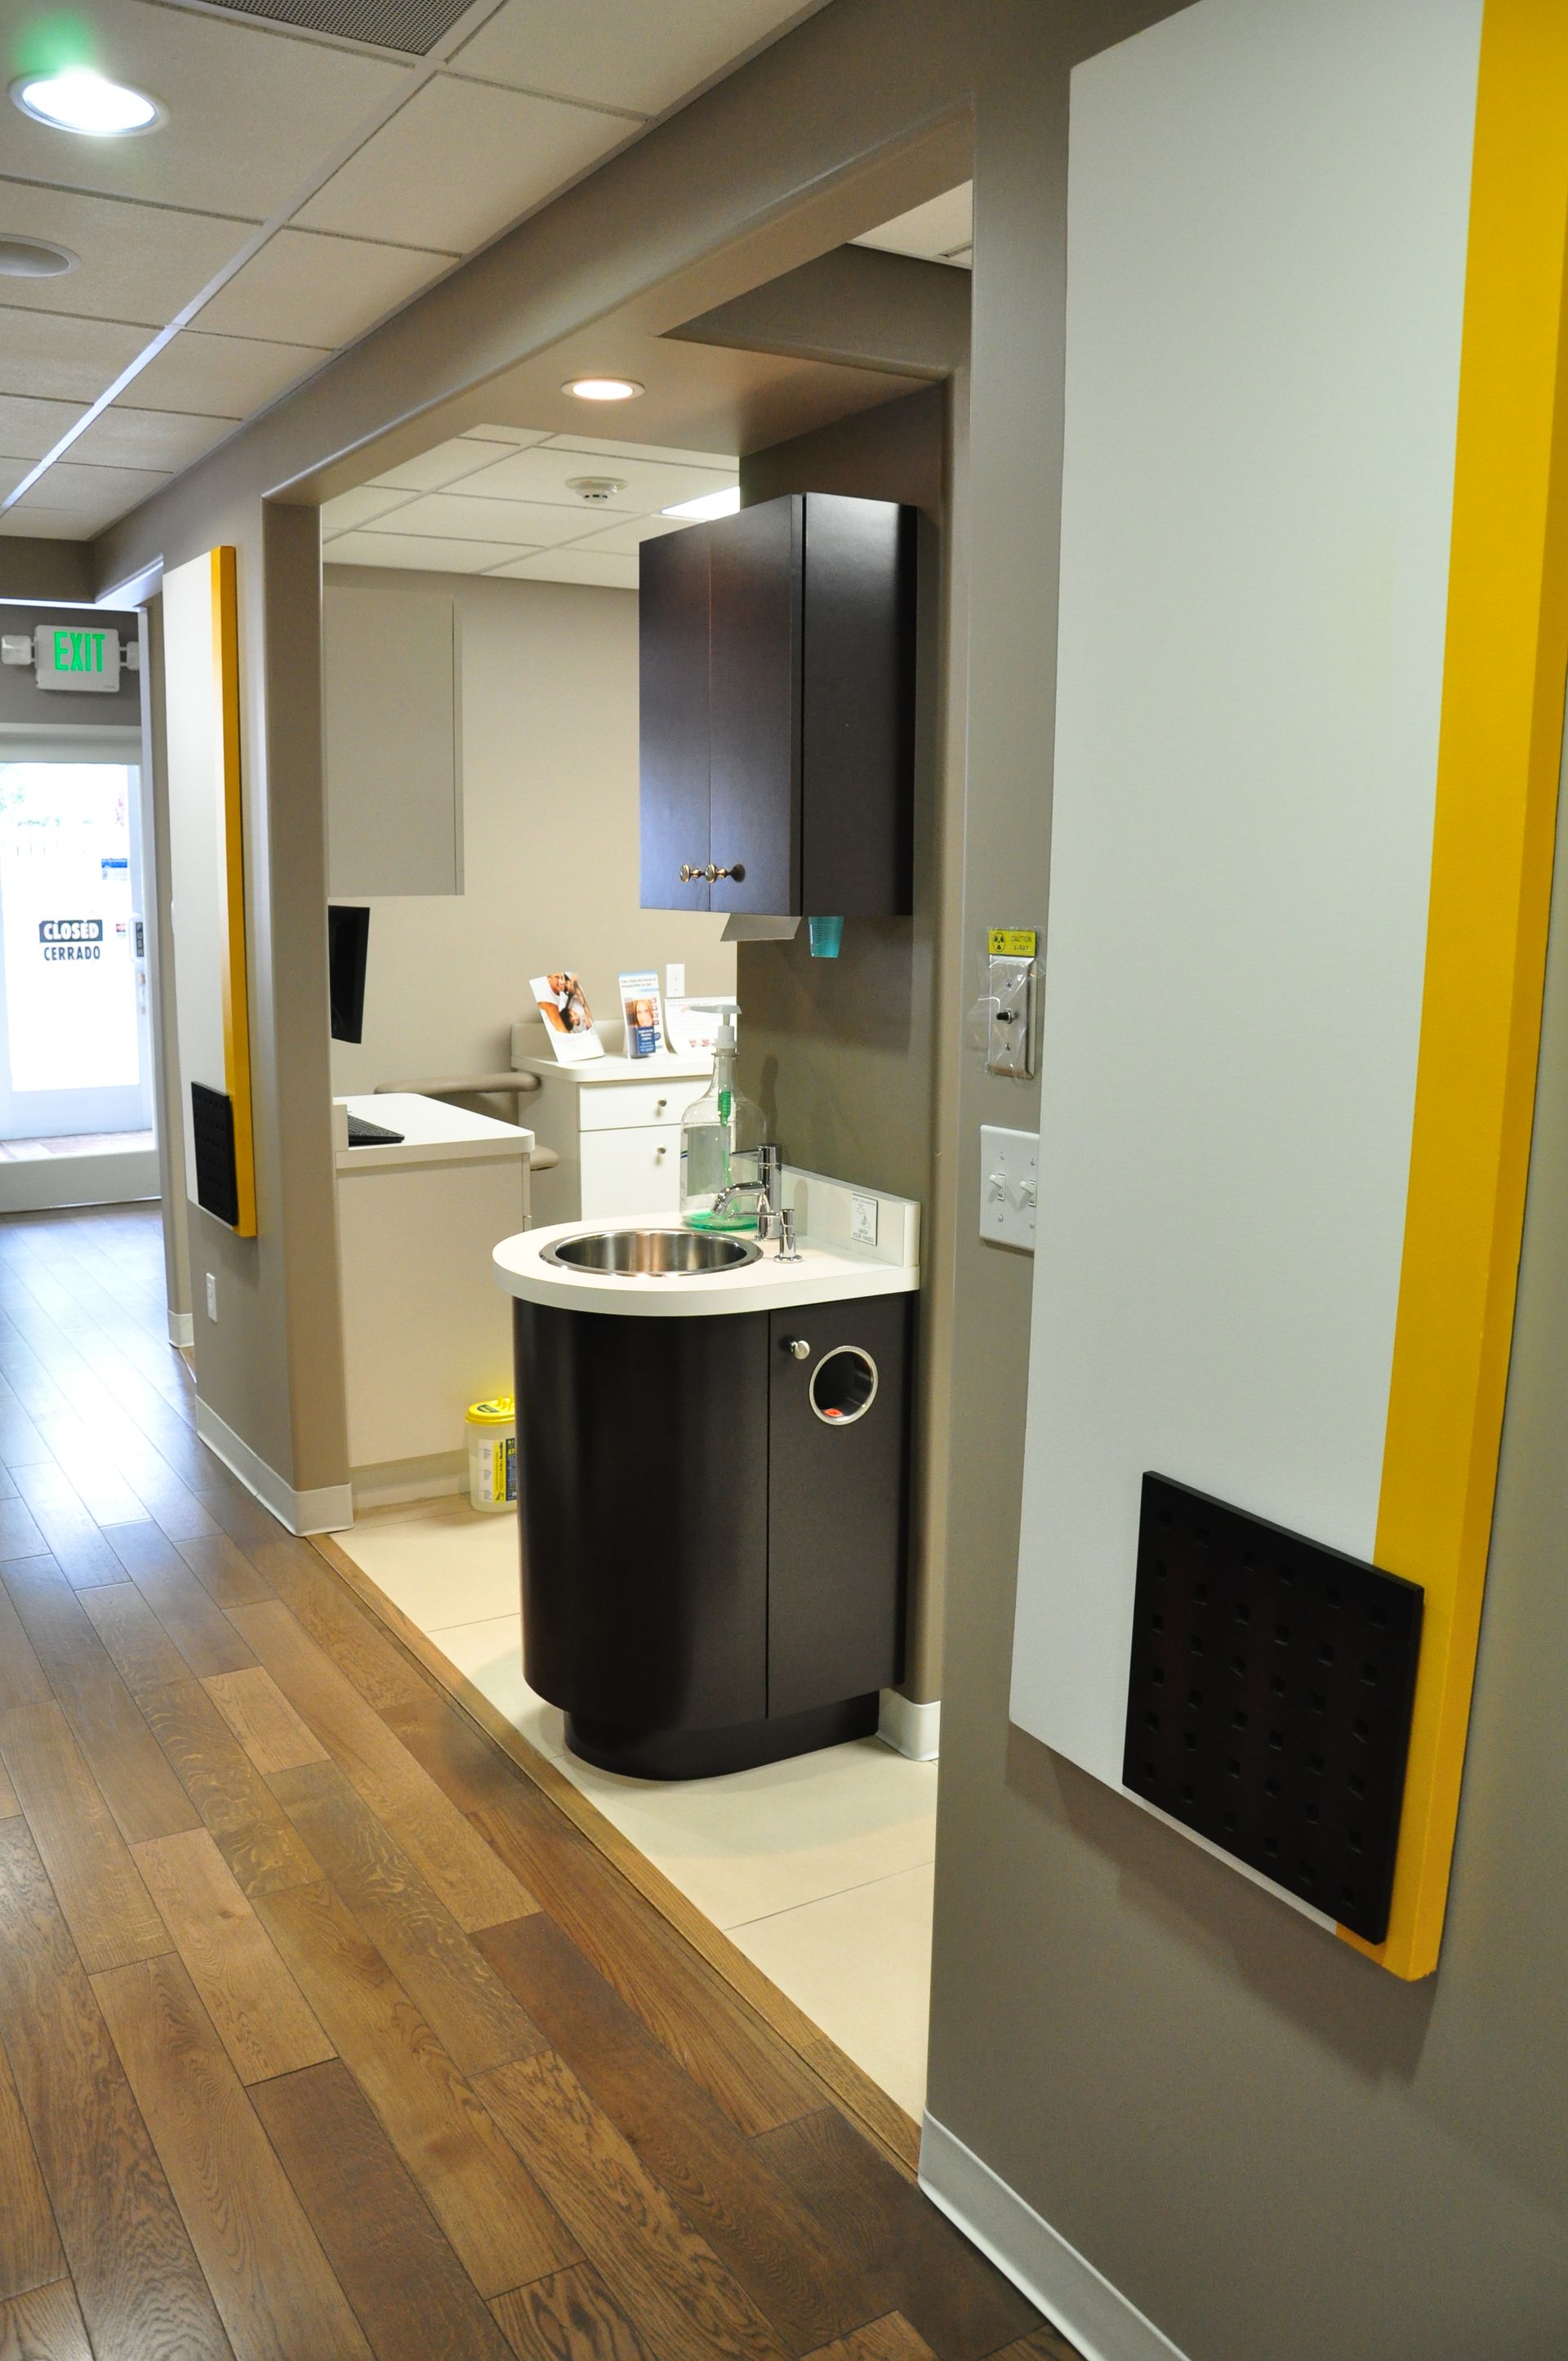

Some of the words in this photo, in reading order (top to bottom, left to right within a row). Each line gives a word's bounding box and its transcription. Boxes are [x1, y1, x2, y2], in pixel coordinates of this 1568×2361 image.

[54, 631, 105, 671] EXIT
[43, 922, 100, 940] CLOSED
[44, 946, 100, 960] CERRADO
